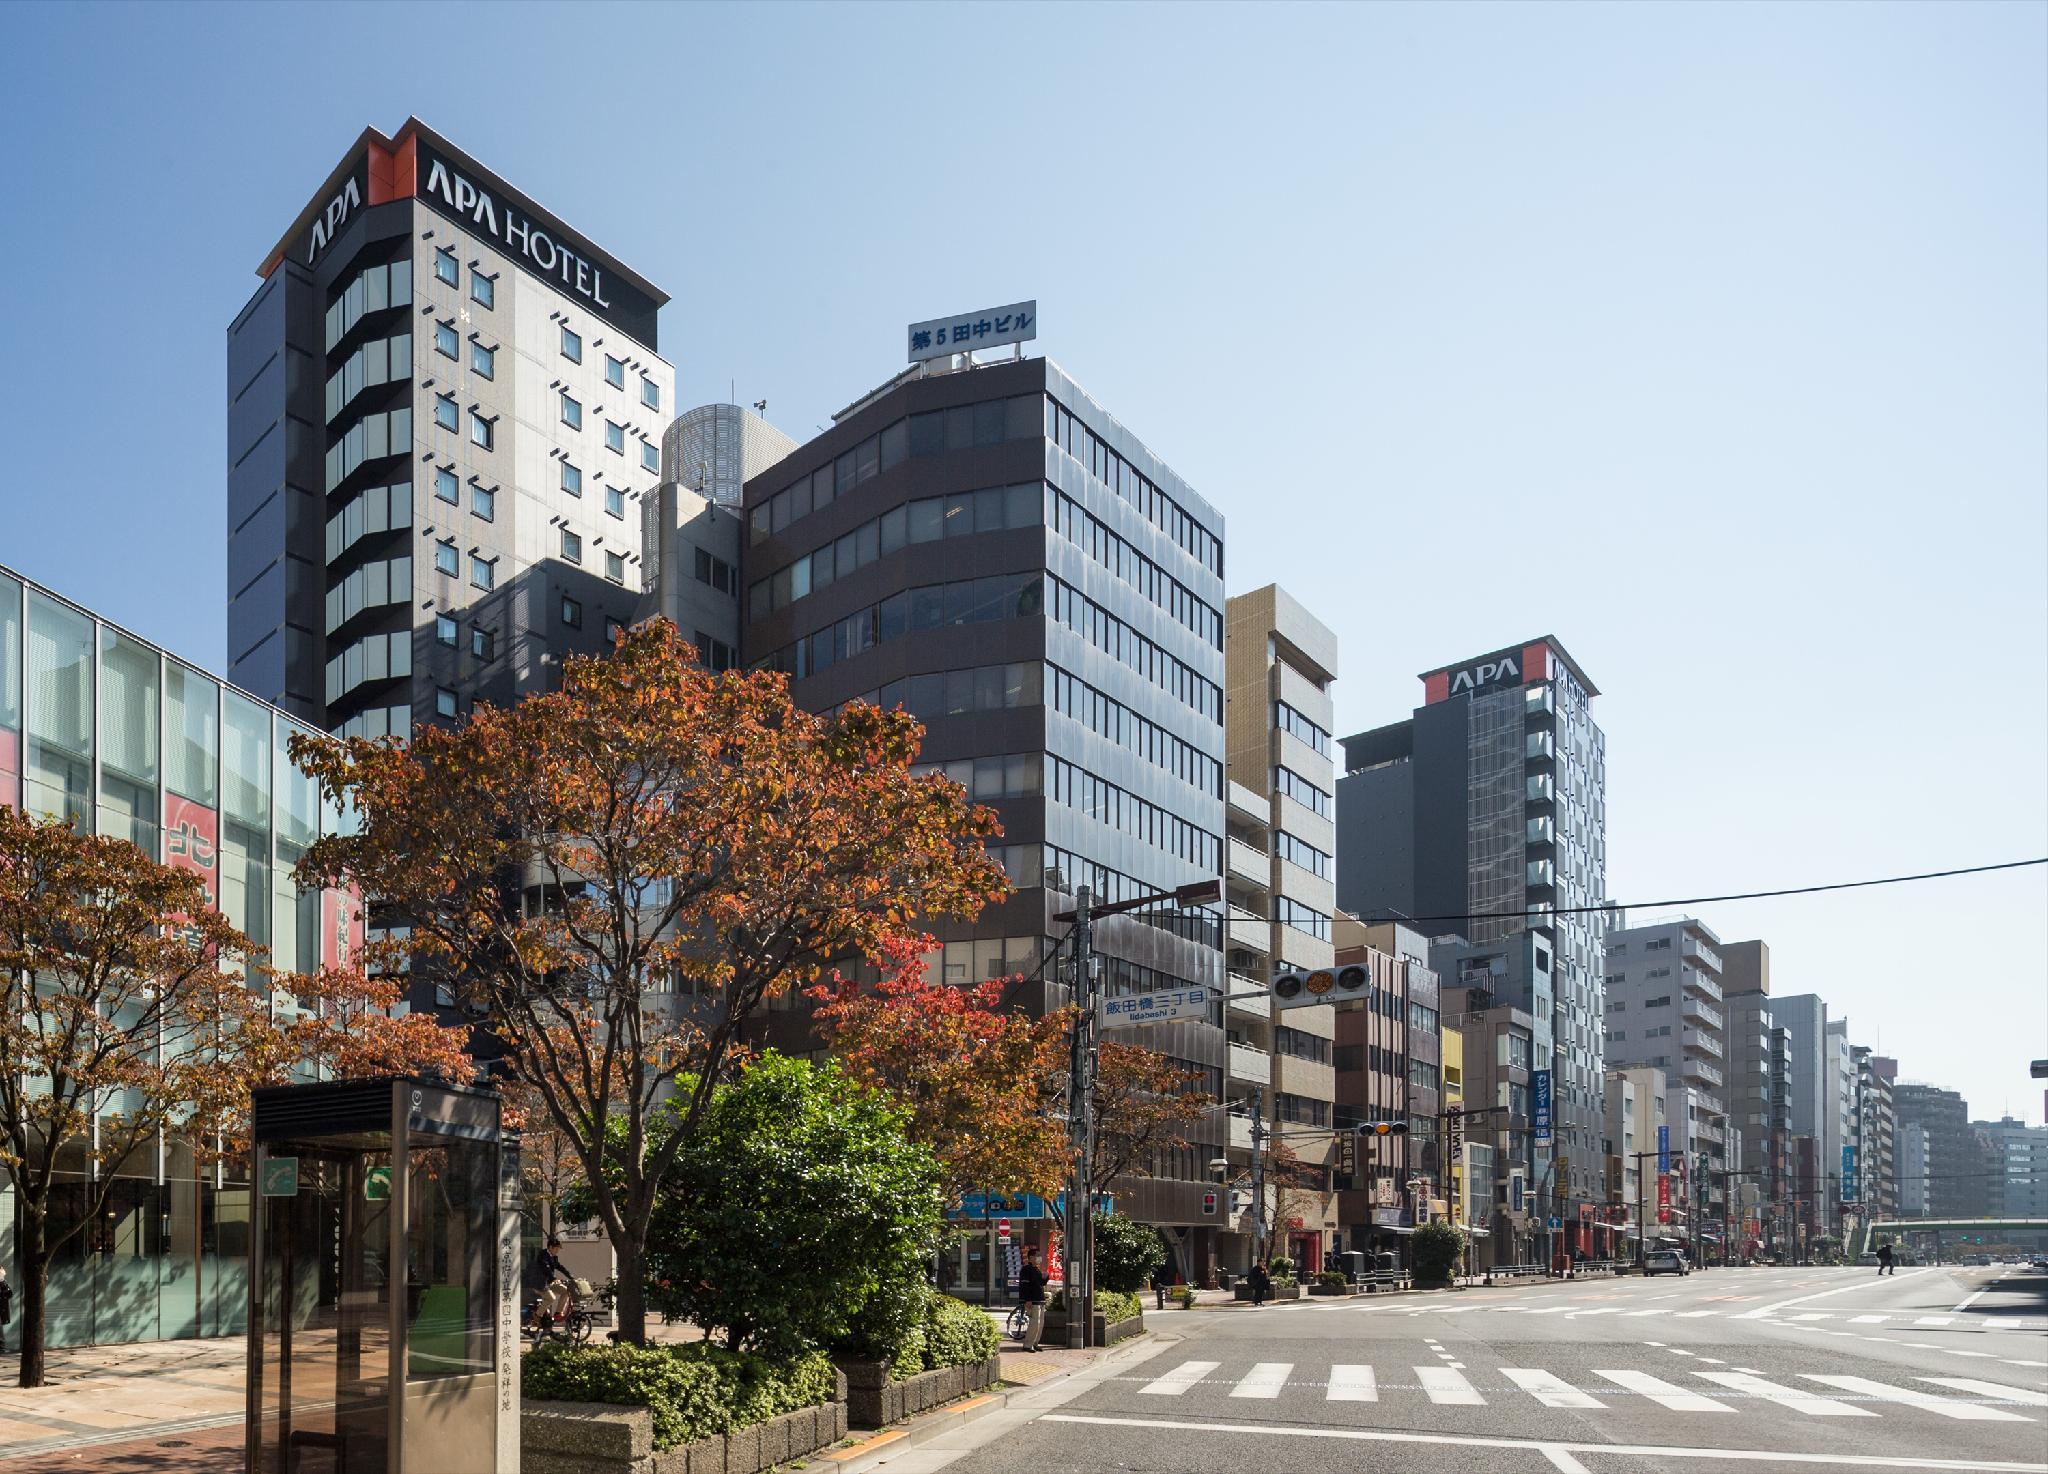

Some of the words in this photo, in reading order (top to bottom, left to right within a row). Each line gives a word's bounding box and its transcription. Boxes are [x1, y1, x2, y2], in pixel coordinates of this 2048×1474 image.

[307, 175, 362, 265] APA
[426, 158, 499, 237] APA
[504, 208, 610, 310] HOTEL
[911, 312, 1034, 352] 第5田中ビル
[1450, 657, 1520, 694] APA
[1105, 990, 1204, 1015] 飯田橋三丁目
[1129, 1008, 1168, 1021] Iidabashi
[1170, 1008, 1177, 1016] 3
[1537, 1074, 1547, 1107] カレンダー
